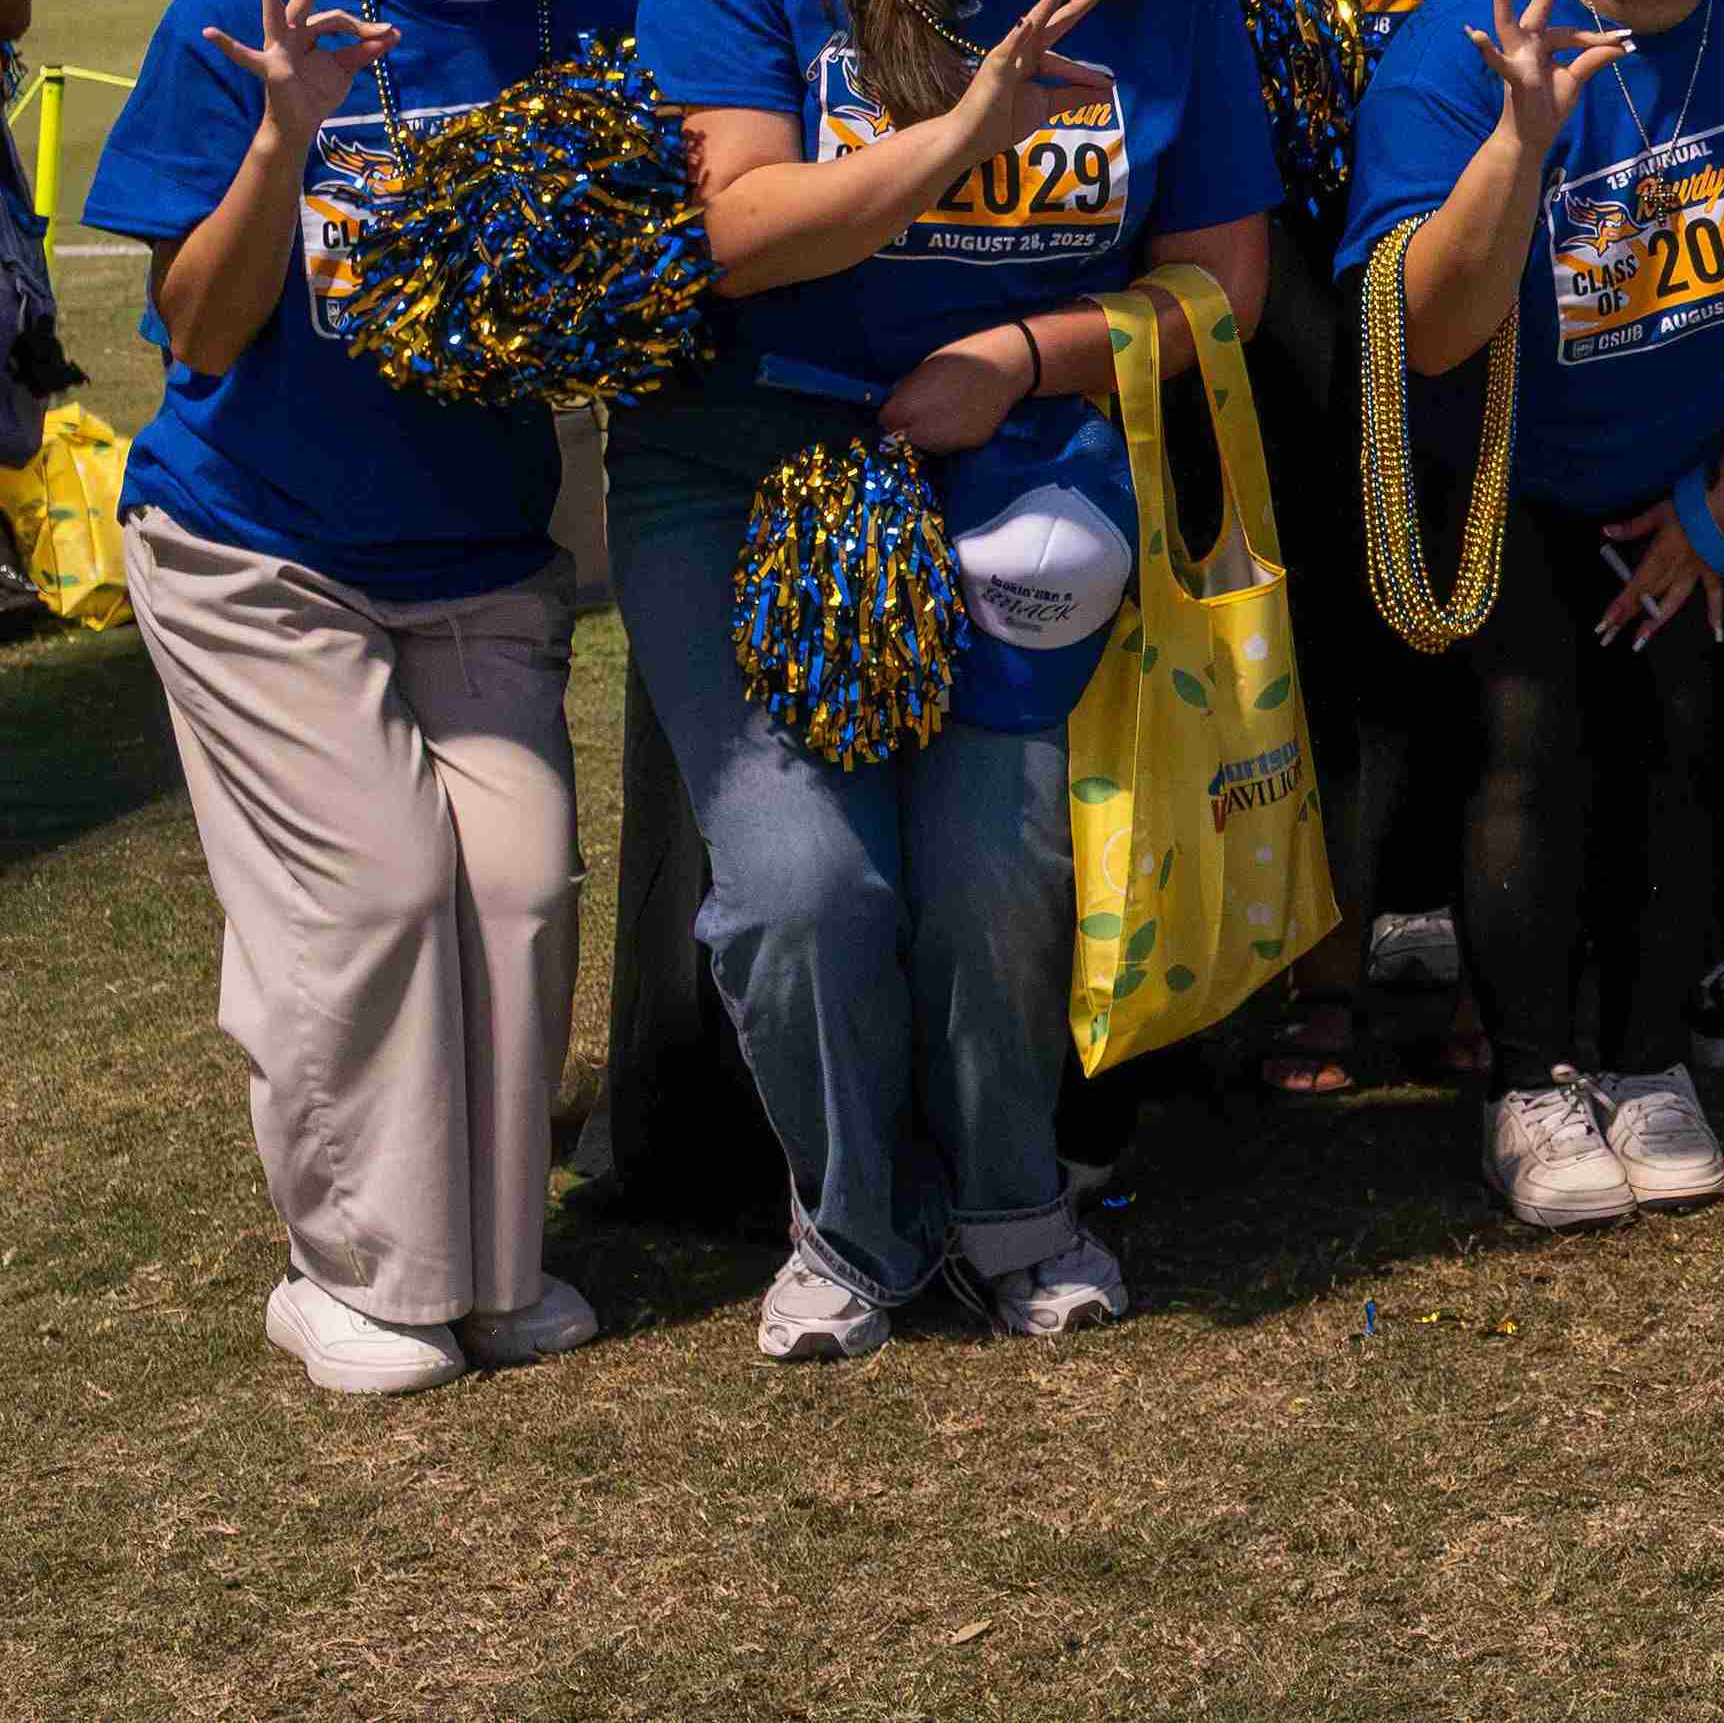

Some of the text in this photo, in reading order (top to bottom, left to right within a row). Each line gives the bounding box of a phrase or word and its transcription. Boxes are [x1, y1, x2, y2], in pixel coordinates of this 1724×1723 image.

[928, 232, 1016, 252] AUGUST
[1049, 232, 1096, 247] 2025
[1573, 253, 1637, 296] CLASS
[1598, 287, 1624, 316] OF
[1599, 324, 1643, 349] CSUB
